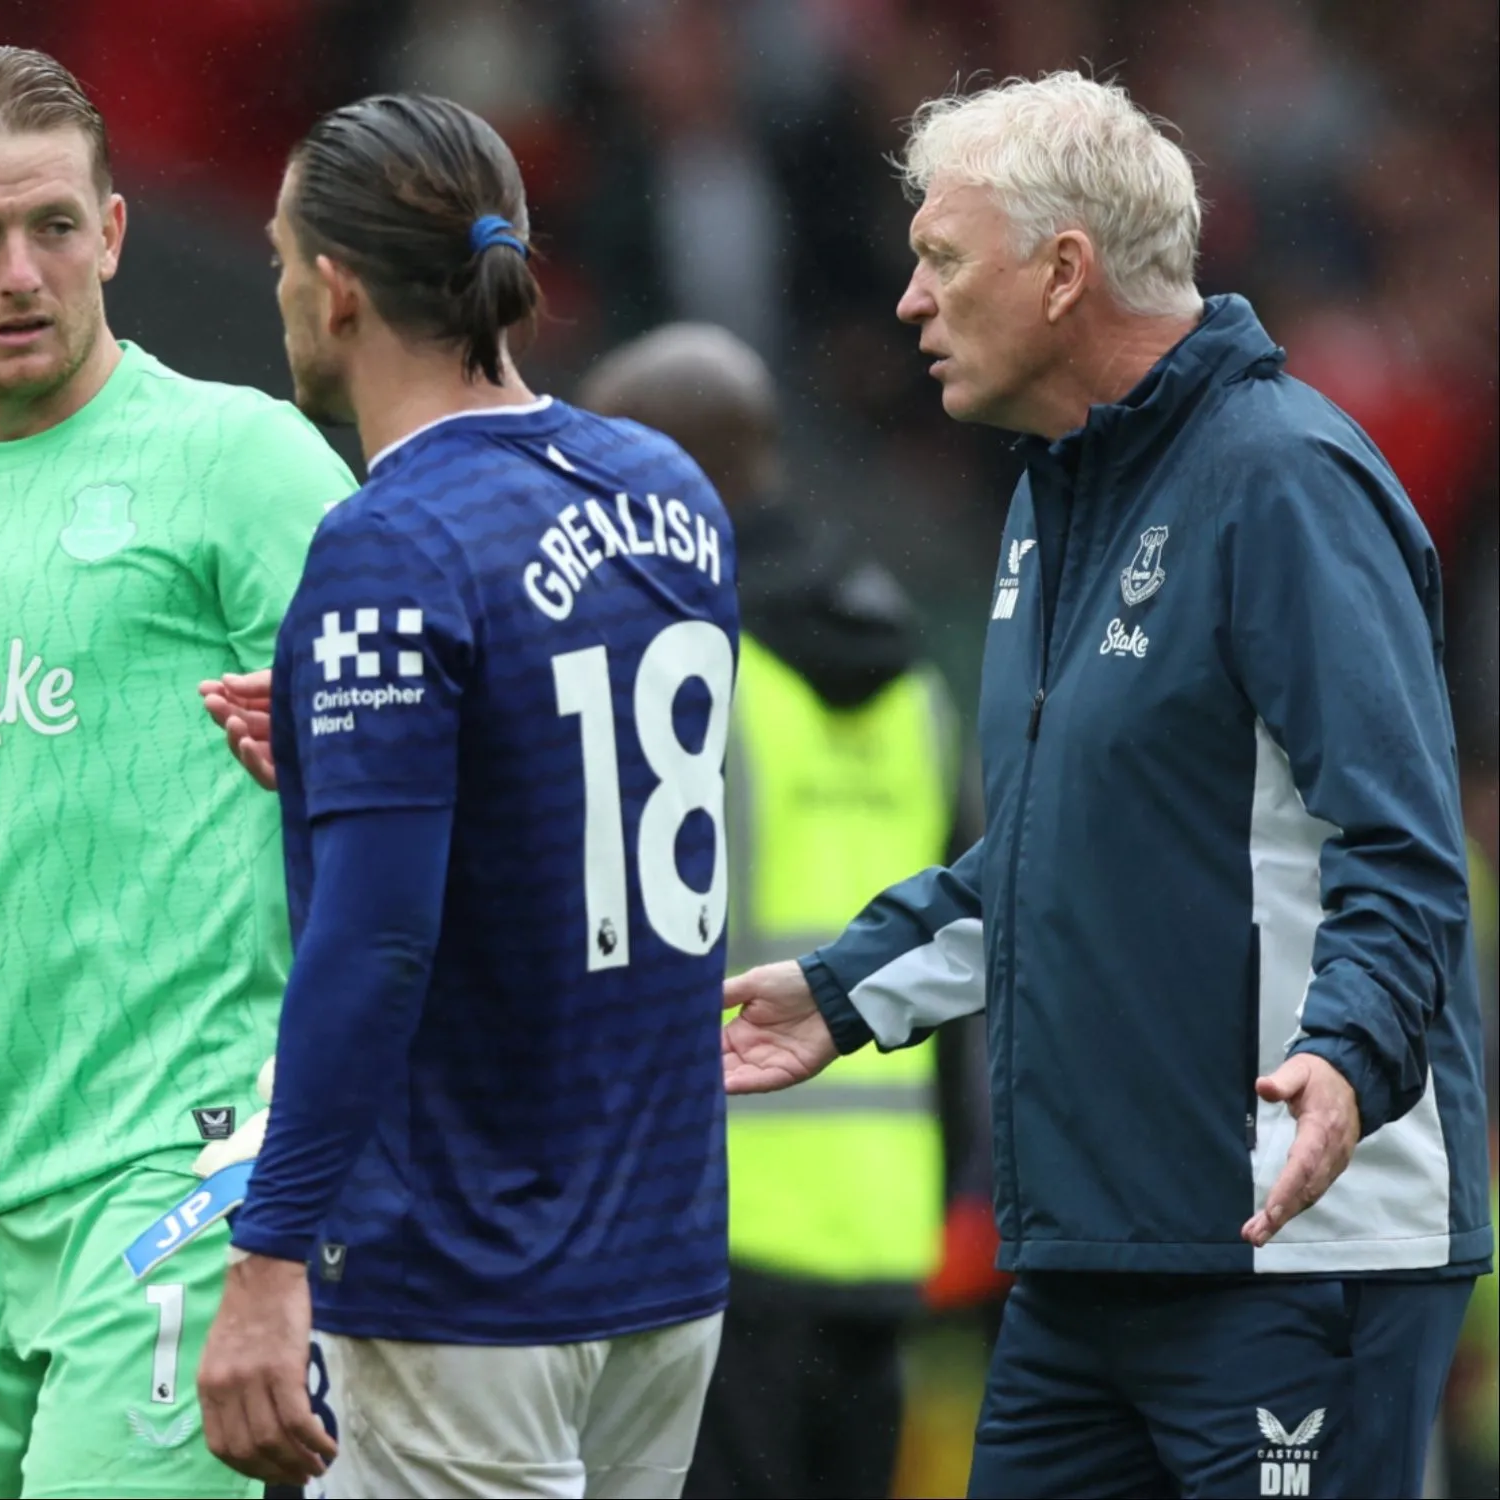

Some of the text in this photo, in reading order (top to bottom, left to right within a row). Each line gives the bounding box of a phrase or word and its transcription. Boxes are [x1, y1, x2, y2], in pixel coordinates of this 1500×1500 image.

[524, 492, 721, 621] GREALISH
[1100, 618, 1149, 658] Stake
[313, 683, 425, 712] Christopher
[311, 711, 355, 737] Ward
[551, 619, 735, 973] 18
[155, 1191, 211, 1248] JP
[146, 1284, 185, 1404] 1
[1257, 1449, 1320, 1460] CASTORE
[1260, 1462, 1311, 1497] DM
